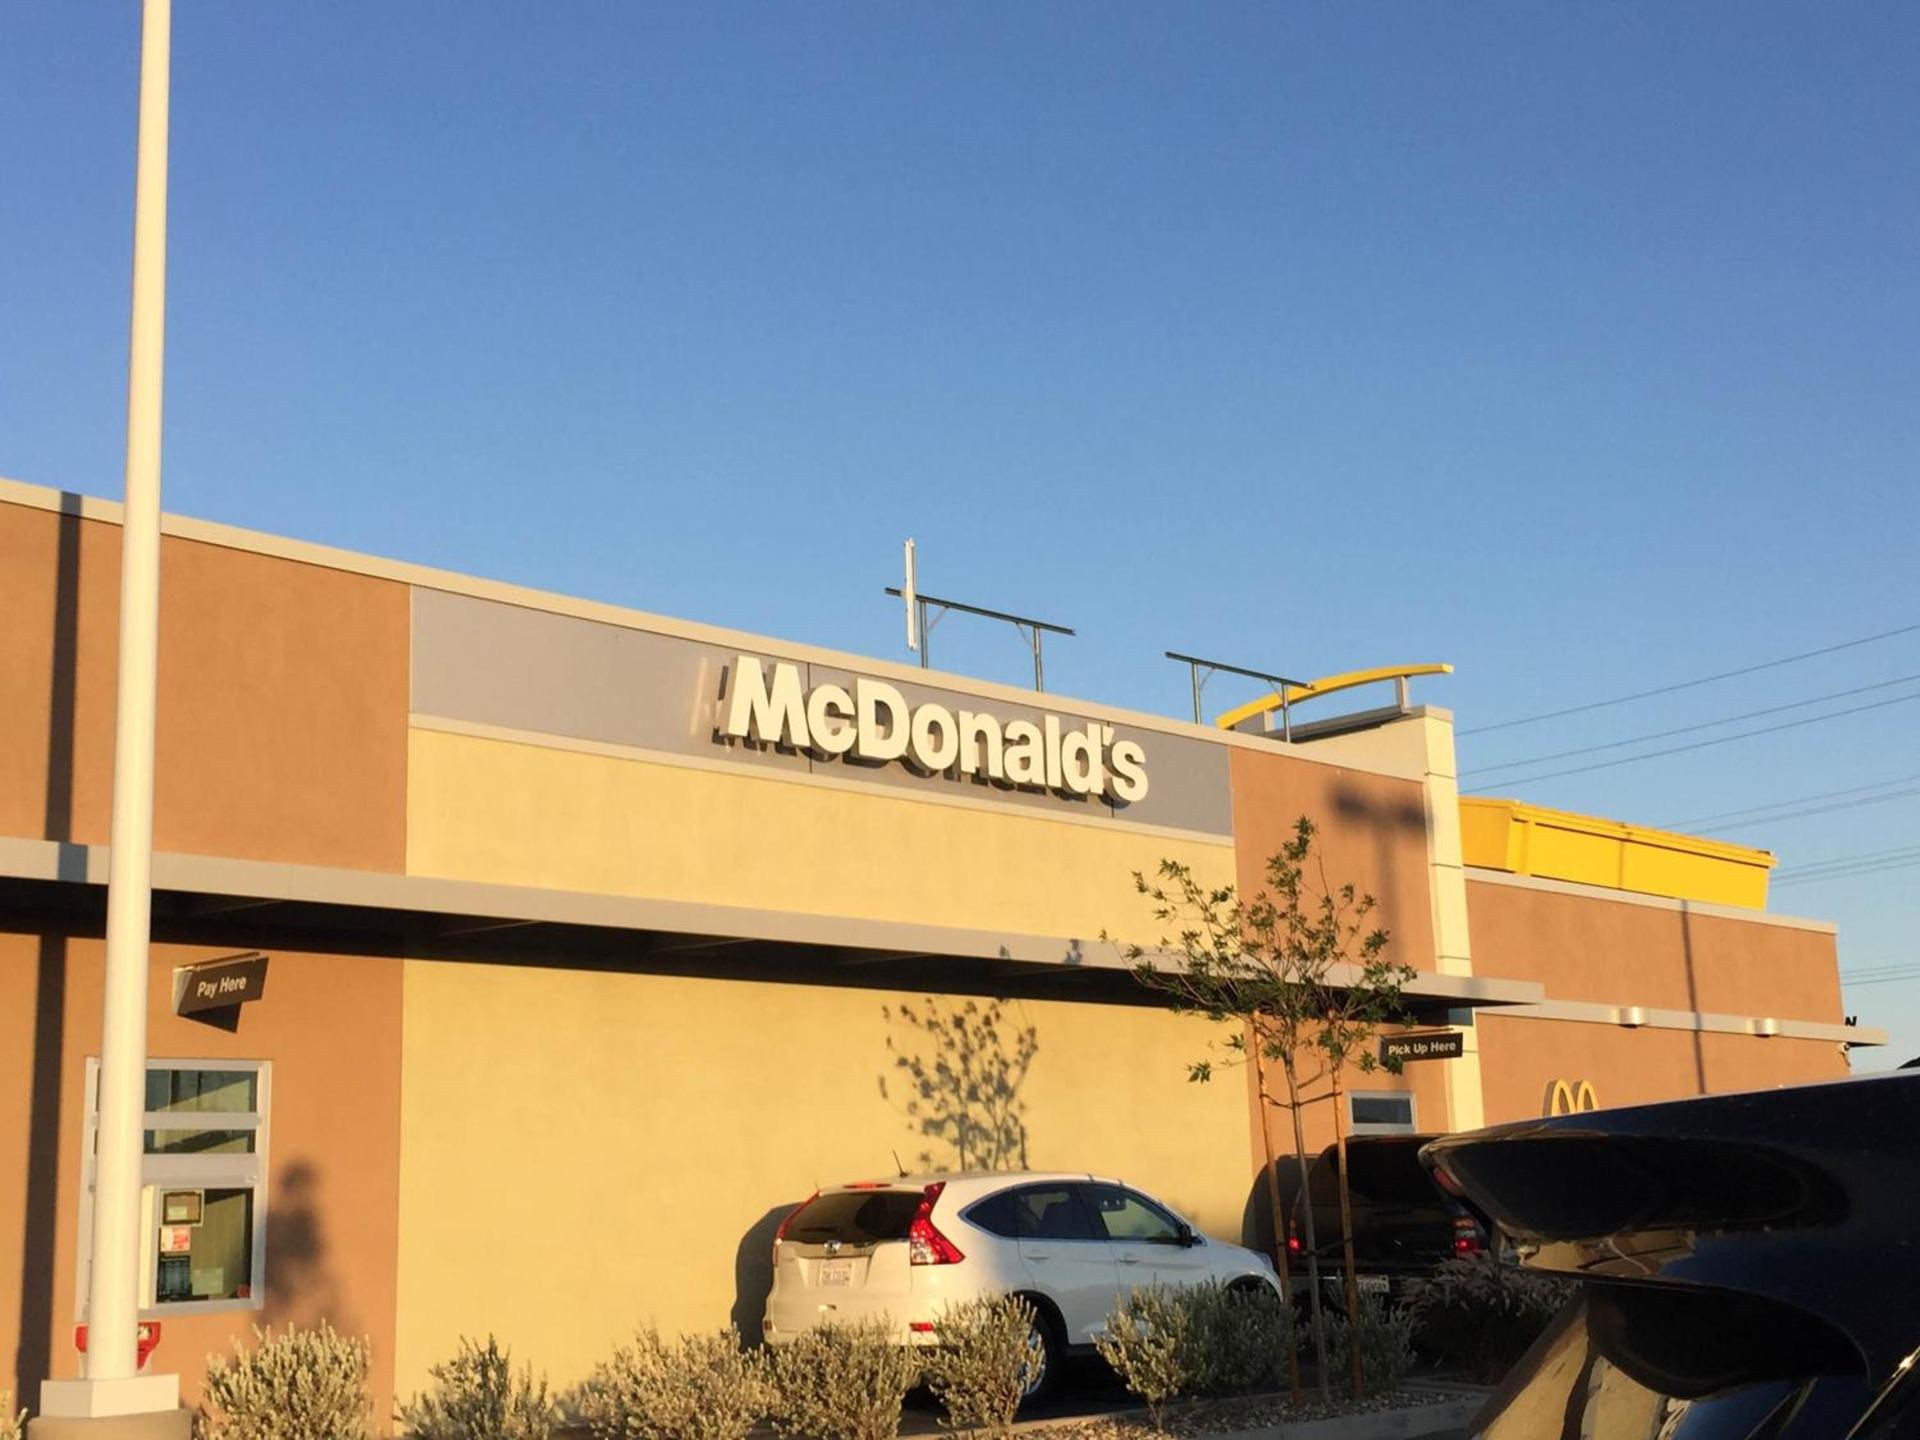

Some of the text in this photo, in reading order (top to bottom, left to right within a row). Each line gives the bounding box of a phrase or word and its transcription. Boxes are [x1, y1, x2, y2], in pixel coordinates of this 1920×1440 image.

[728, 655, 1149, 802] McDonald's
[197, 976, 247, 998] Pay Here
[1388, 1041, 1456, 1055] Pick Up Here
